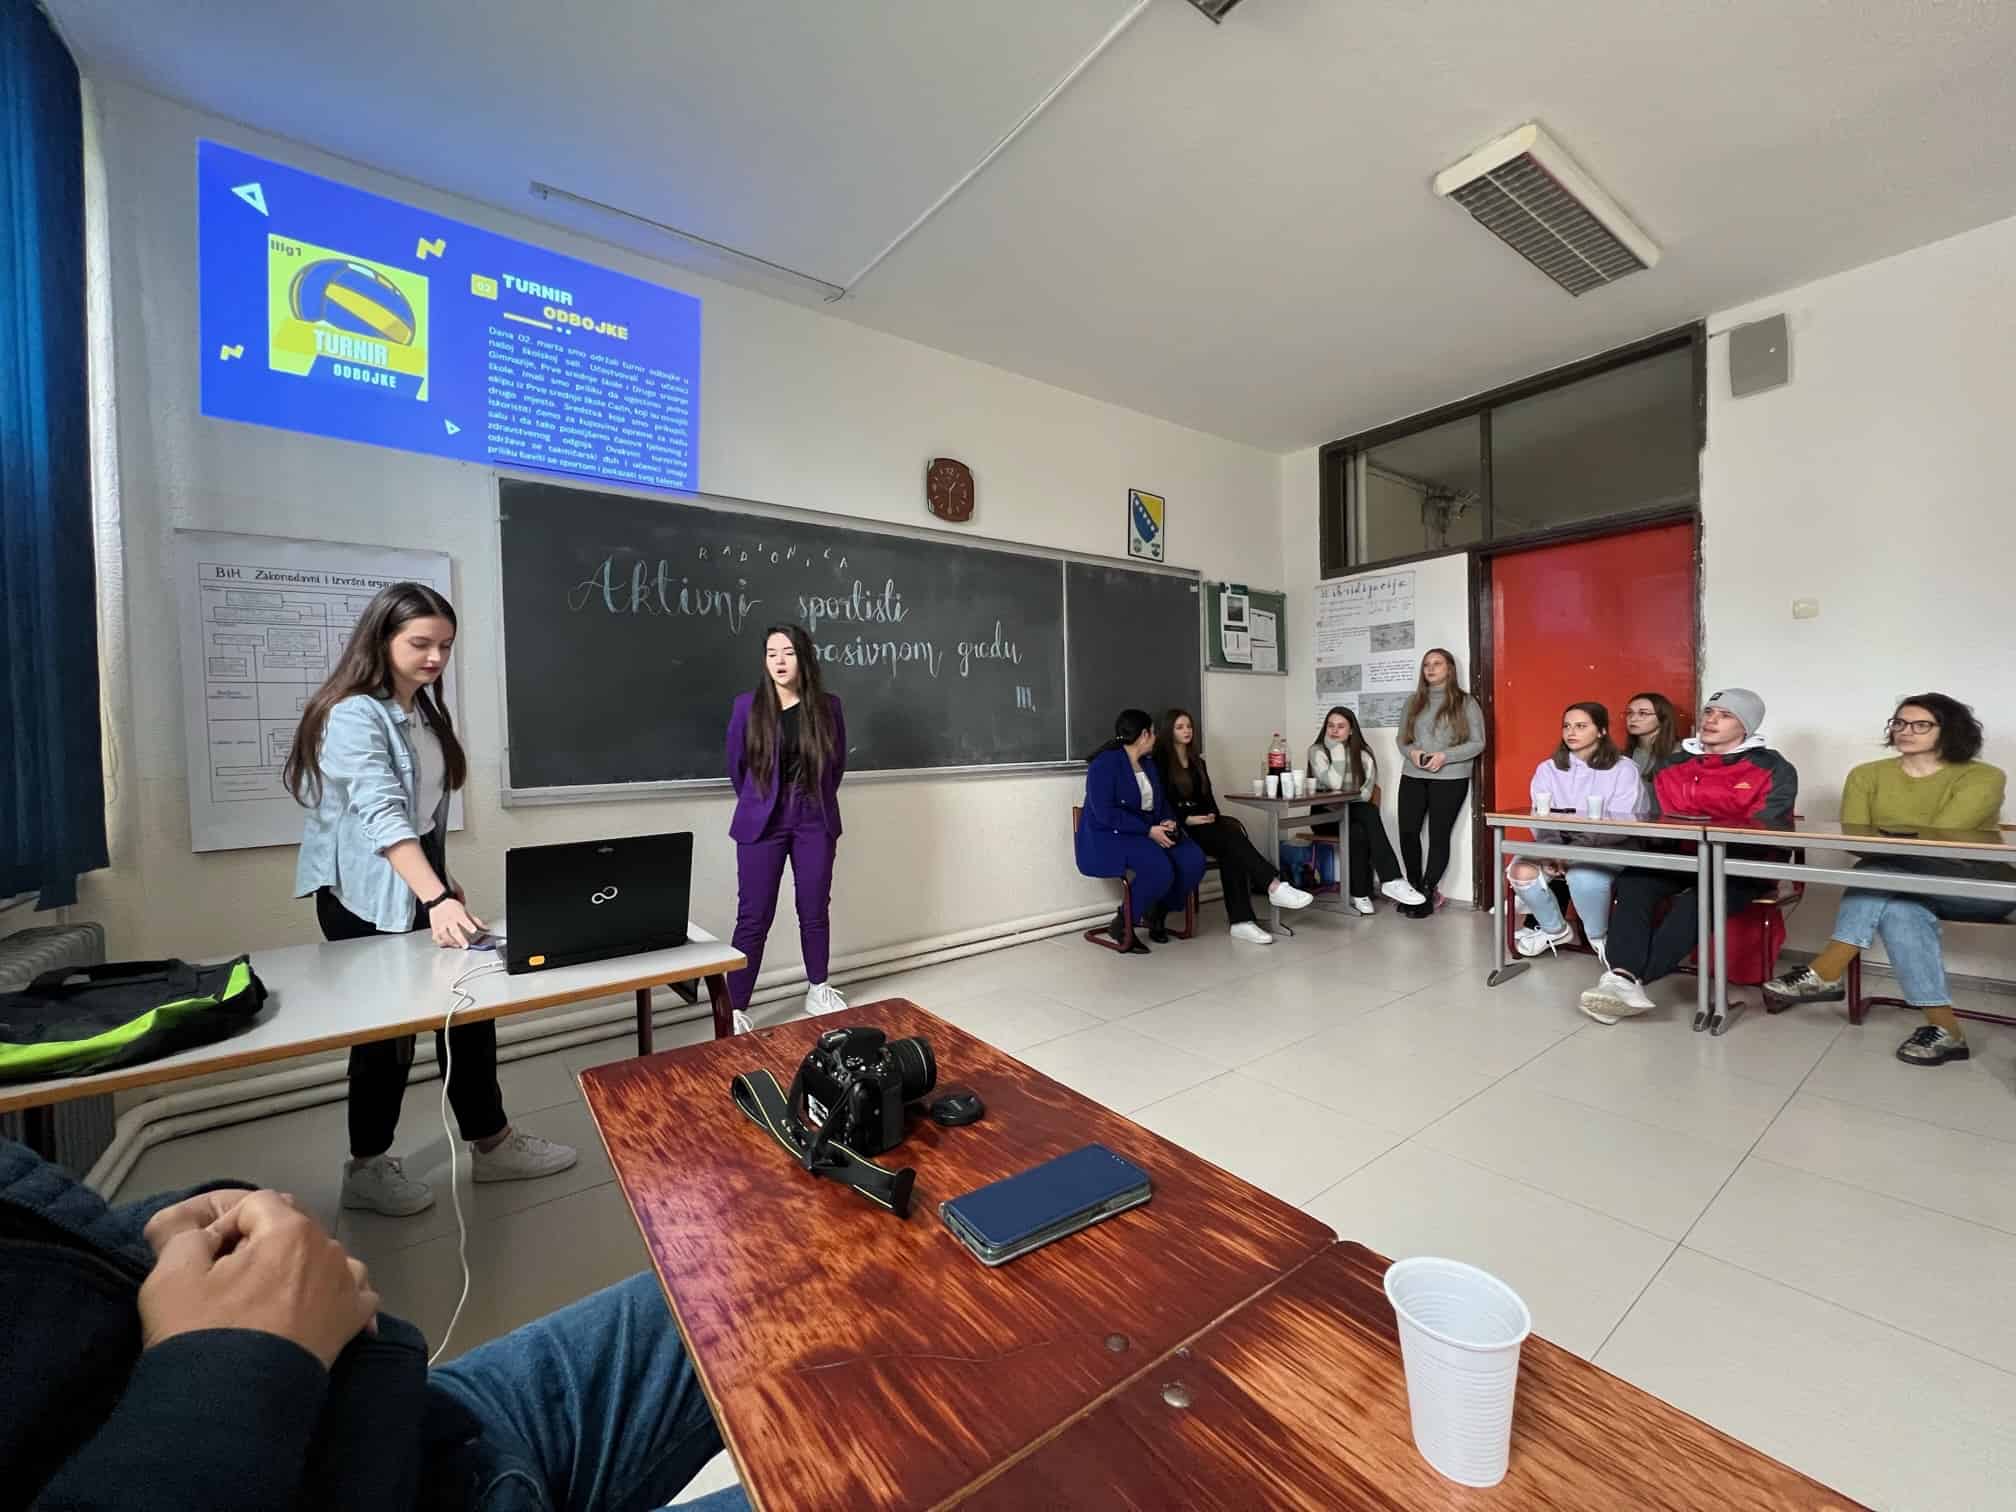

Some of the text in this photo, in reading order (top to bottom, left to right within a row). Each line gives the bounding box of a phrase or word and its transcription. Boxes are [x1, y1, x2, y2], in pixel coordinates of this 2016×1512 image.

[502, 273, 574, 306] TURNIR
[488, 327, 513, 339] Dana
[543, 306, 629, 340] ODBOJKE
[314, 329, 388, 368] TURNIR
[333, 363, 397, 388] ODBOJKE
[216, 567, 241, 579] BiH
[568, 554, 911, 635] Aktivni sportisti
[957, 620, 1023, 677] gradu
